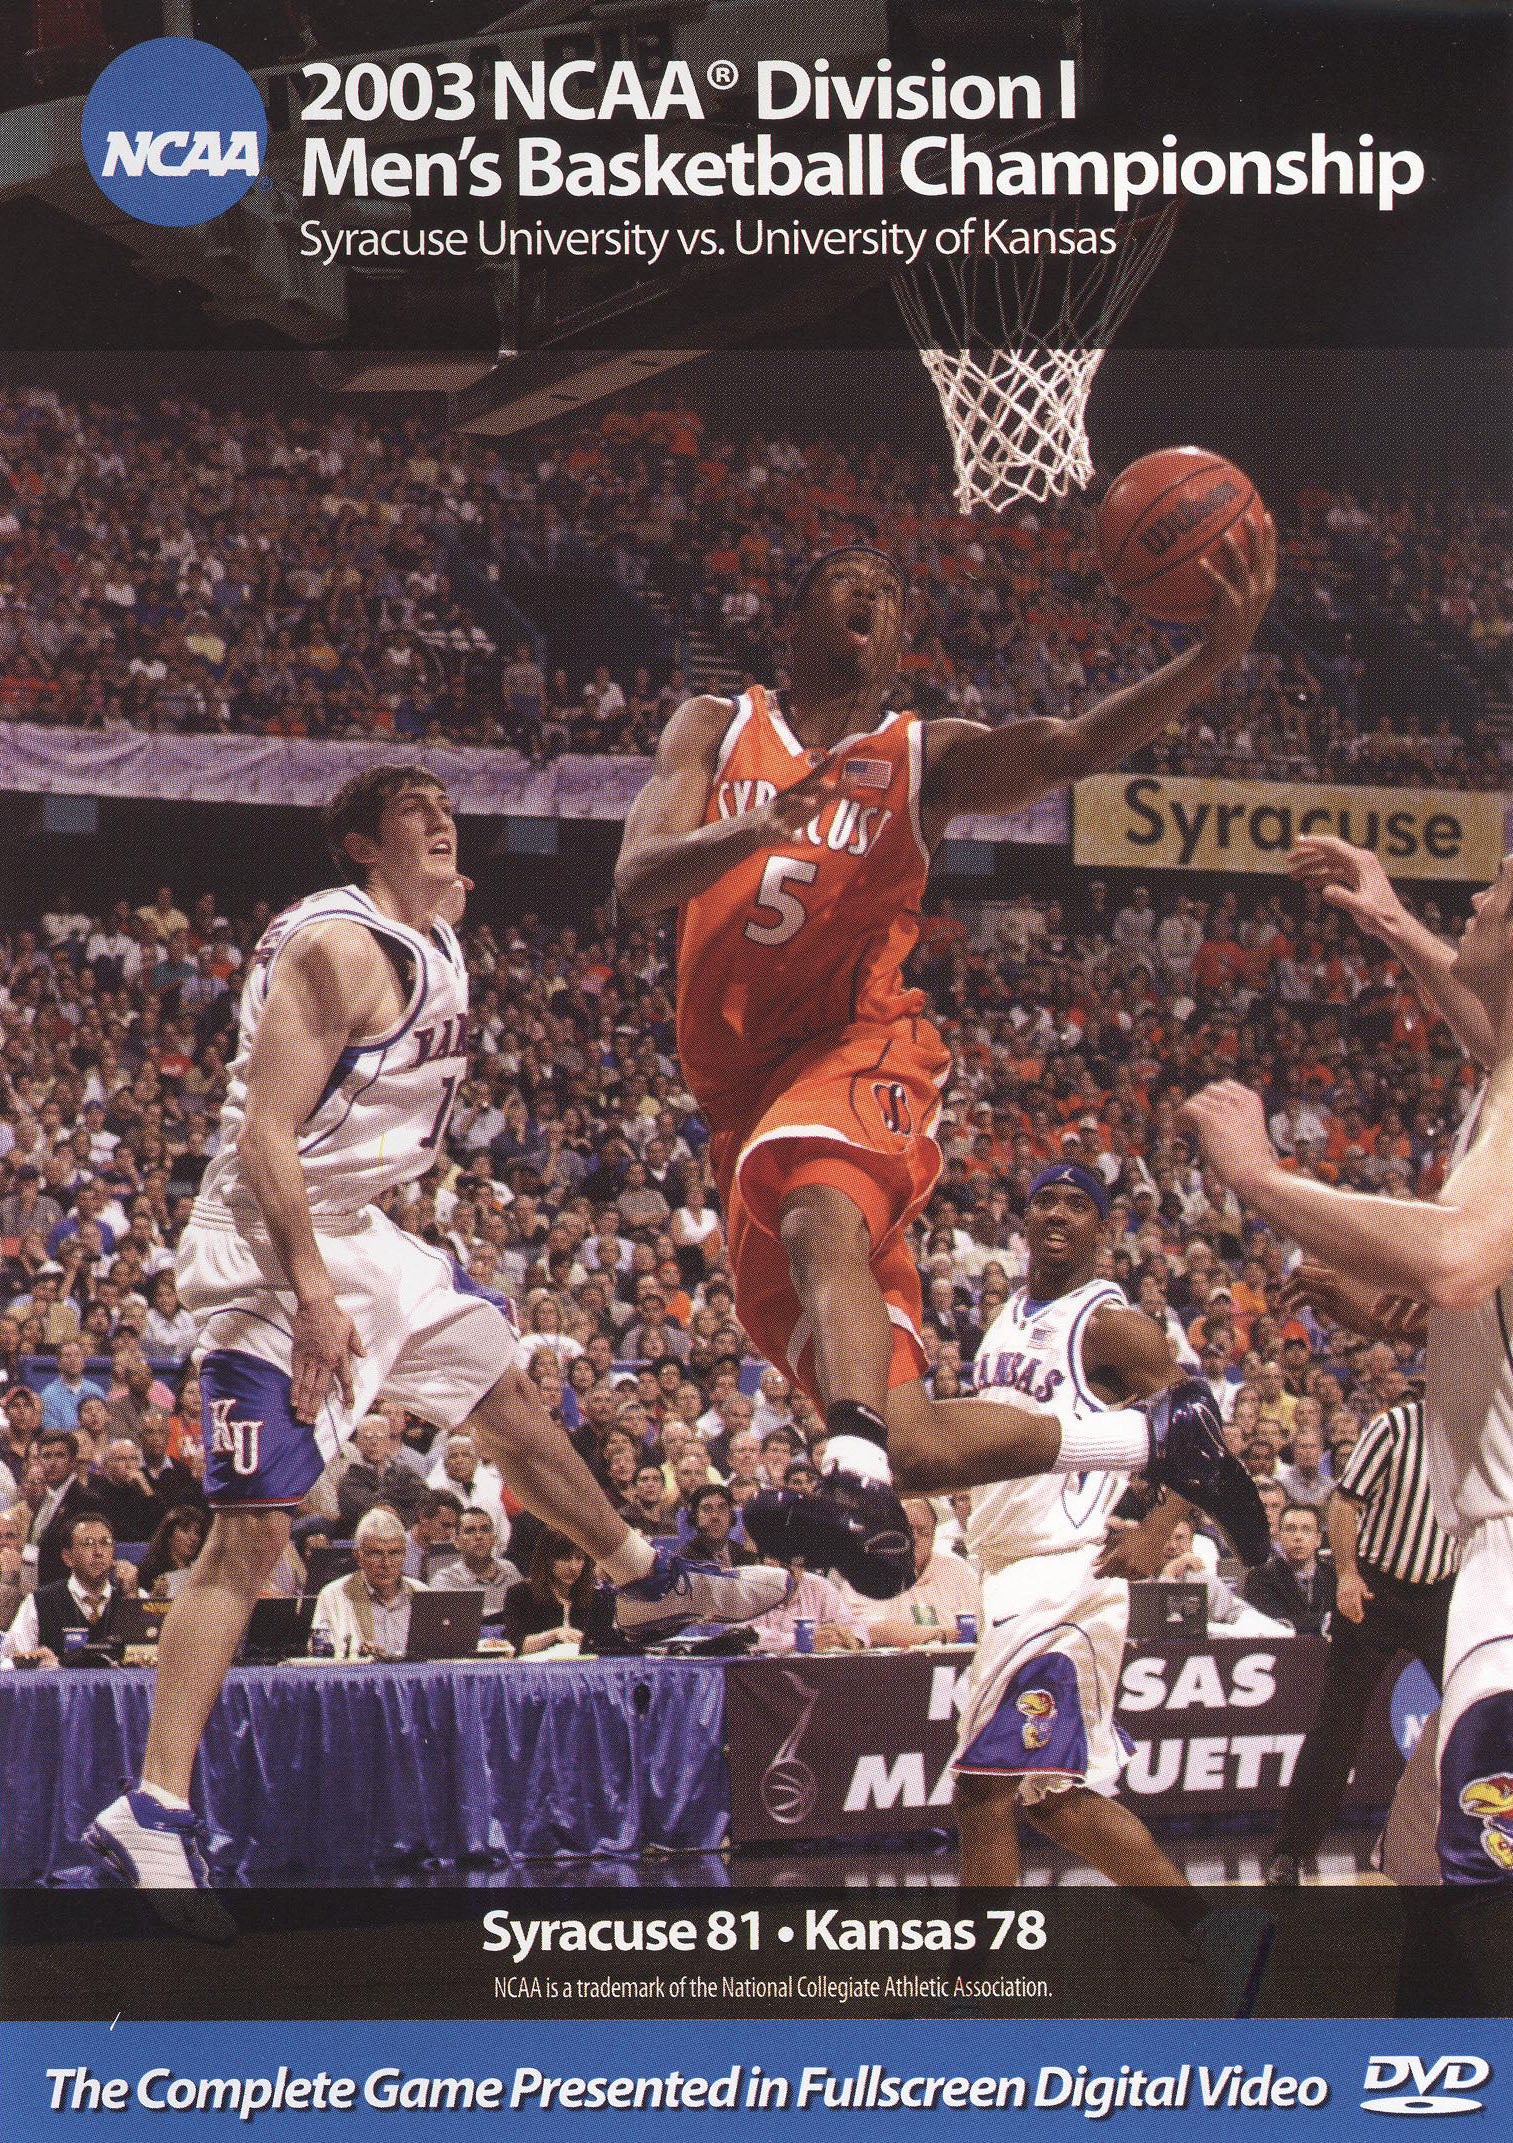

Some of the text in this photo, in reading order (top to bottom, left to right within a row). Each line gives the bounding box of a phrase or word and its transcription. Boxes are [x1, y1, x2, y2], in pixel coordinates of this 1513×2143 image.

[743, 855, 819, 947] 5
[209, 1398, 264, 1477] KU
[927, 1653, 1277, 1721] KSAS
